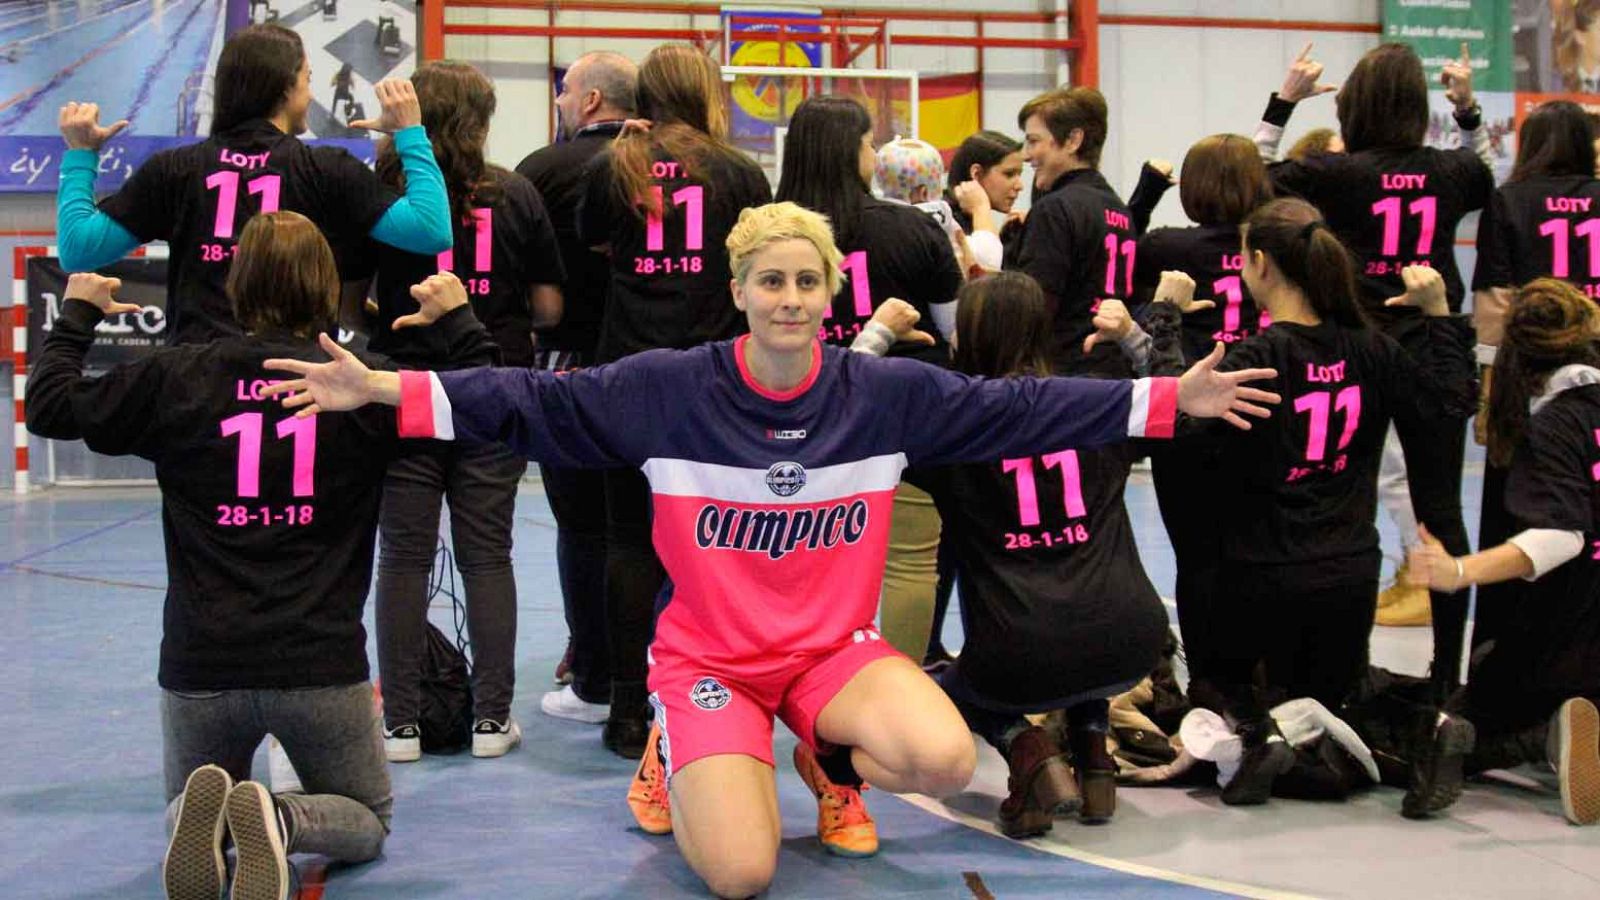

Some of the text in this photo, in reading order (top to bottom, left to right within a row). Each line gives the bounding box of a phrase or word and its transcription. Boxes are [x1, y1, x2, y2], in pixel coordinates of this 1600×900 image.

[220, 148, 271, 170] LOTY
[648, 161, 688, 178] OT
[205, 170, 281, 238] 11
[1381, 174, 1427, 190] LOTY
[1104, 209, 1130, 231] LOTY
[1372, 196, 1437, 256] 11
[1547, 197, 1593, 213] LOTY
[633, 256, 703, 274] 28-1-18
[1104, 232, 1137, 297] 11
[1539, 218, 1600, 278] 11
[1293, 384, 1361, 461] 11
[220, 411, 317, 498] 11
[1002, 449, 1087, 526] 11
[216, 504, 314, 526] 28-1-18
[696, 500, 869, 560] OLIMPICO
[1004, 522, 1090, 550] 28-1-18
